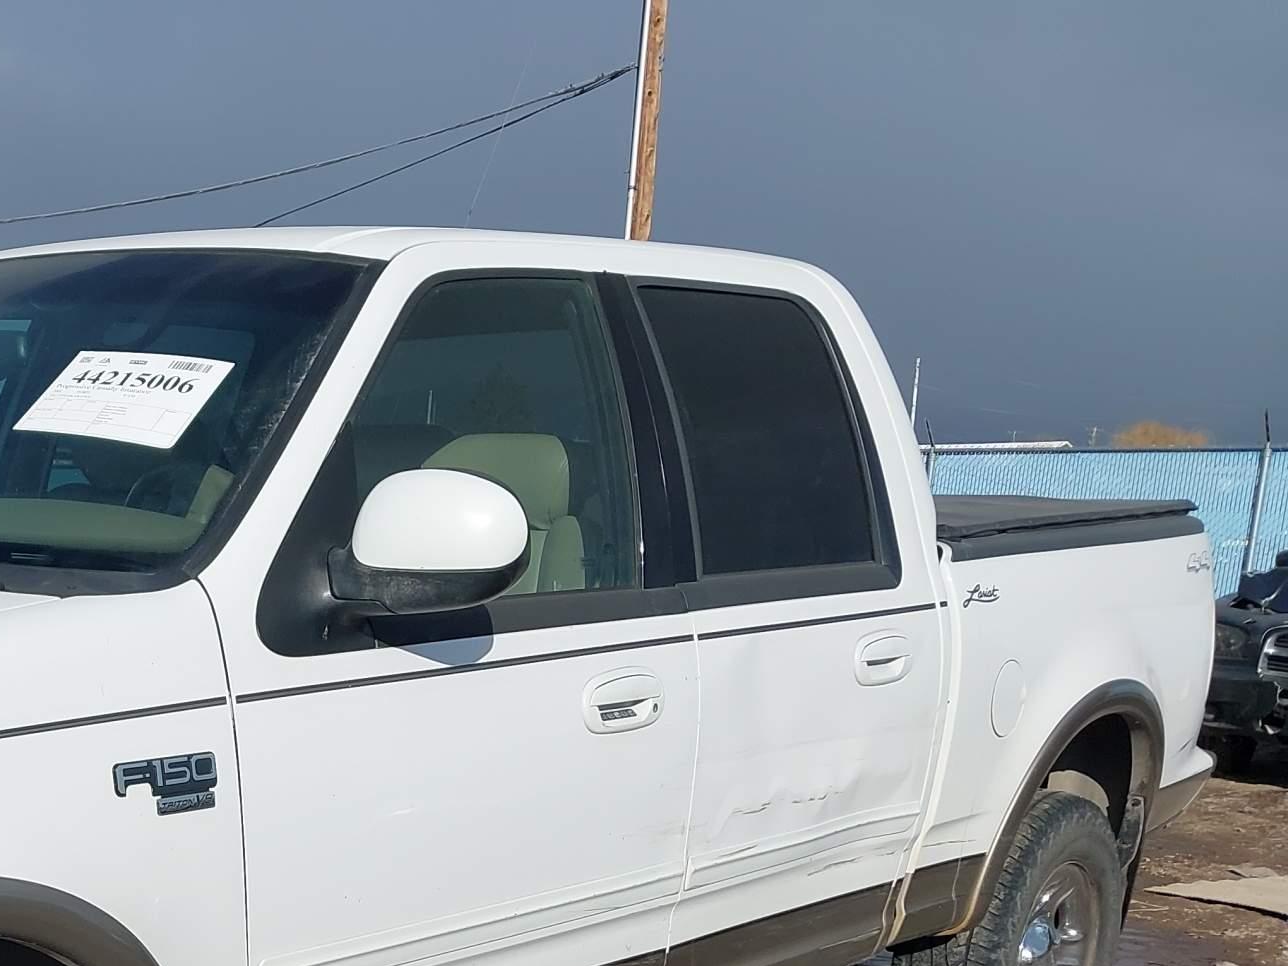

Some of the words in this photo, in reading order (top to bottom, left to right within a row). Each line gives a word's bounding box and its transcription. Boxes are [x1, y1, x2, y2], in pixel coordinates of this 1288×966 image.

[72, 369, 200, 394] 44215006
[963, 583, 1000, 608] Lariat
[115, 754, 216, 795] F-150
